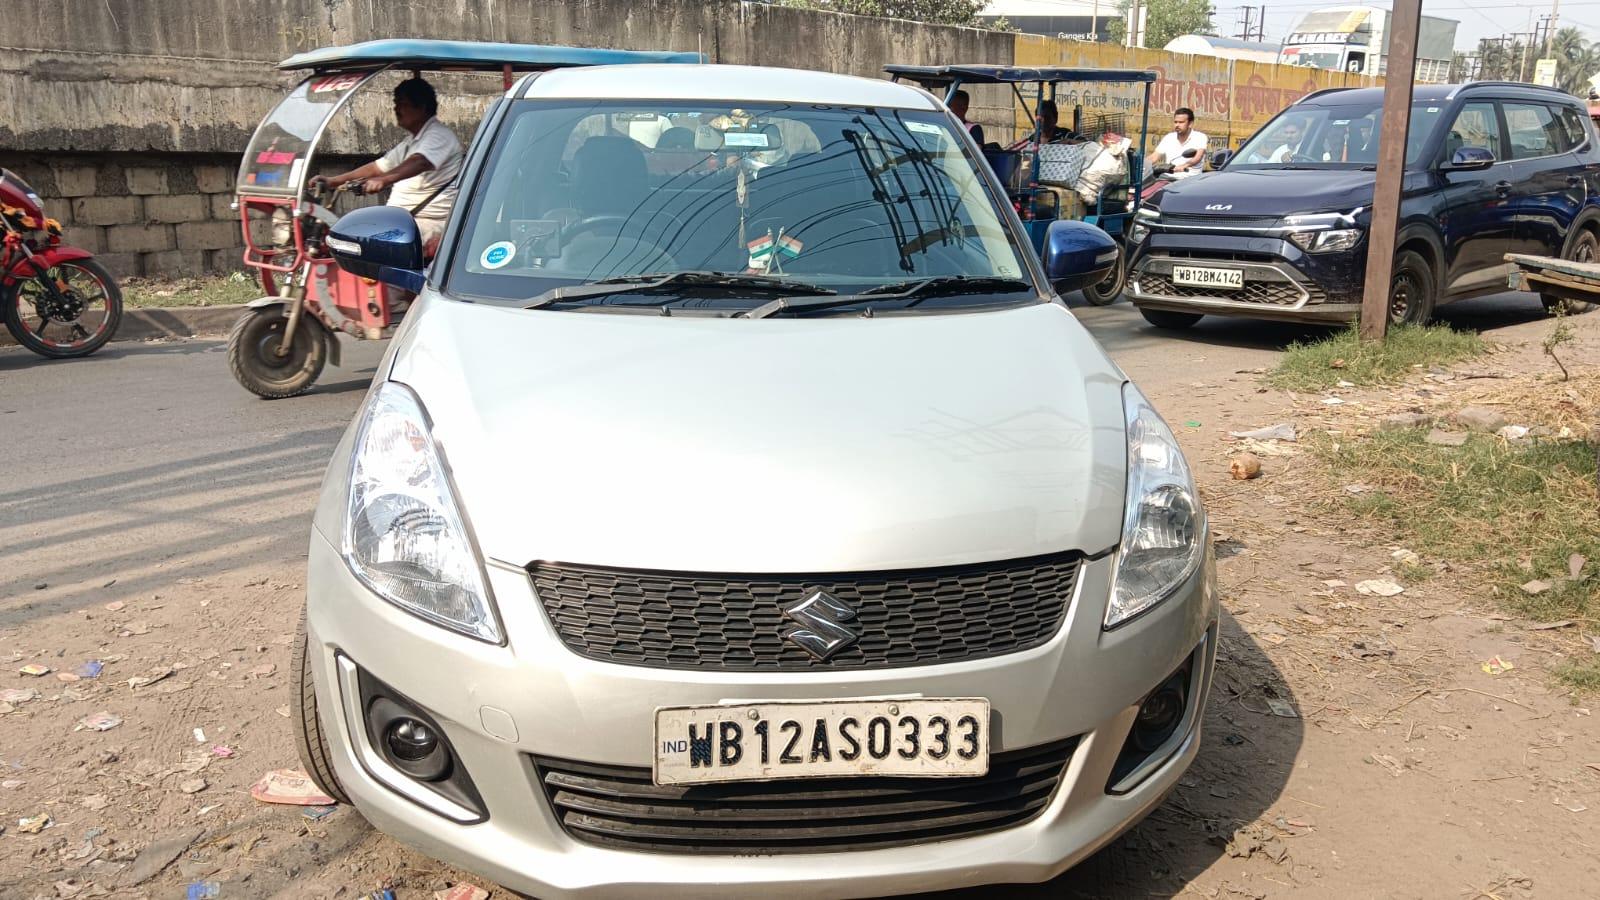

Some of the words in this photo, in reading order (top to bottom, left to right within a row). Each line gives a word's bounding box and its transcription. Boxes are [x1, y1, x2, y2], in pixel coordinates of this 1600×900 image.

[1086, 32, 1098, 40] Ka
[1179, 269, 1241, 285] WB12BM4142
[662, 740, 688, 754] IND
[687, 714, 980, 768] WB12AS0333
